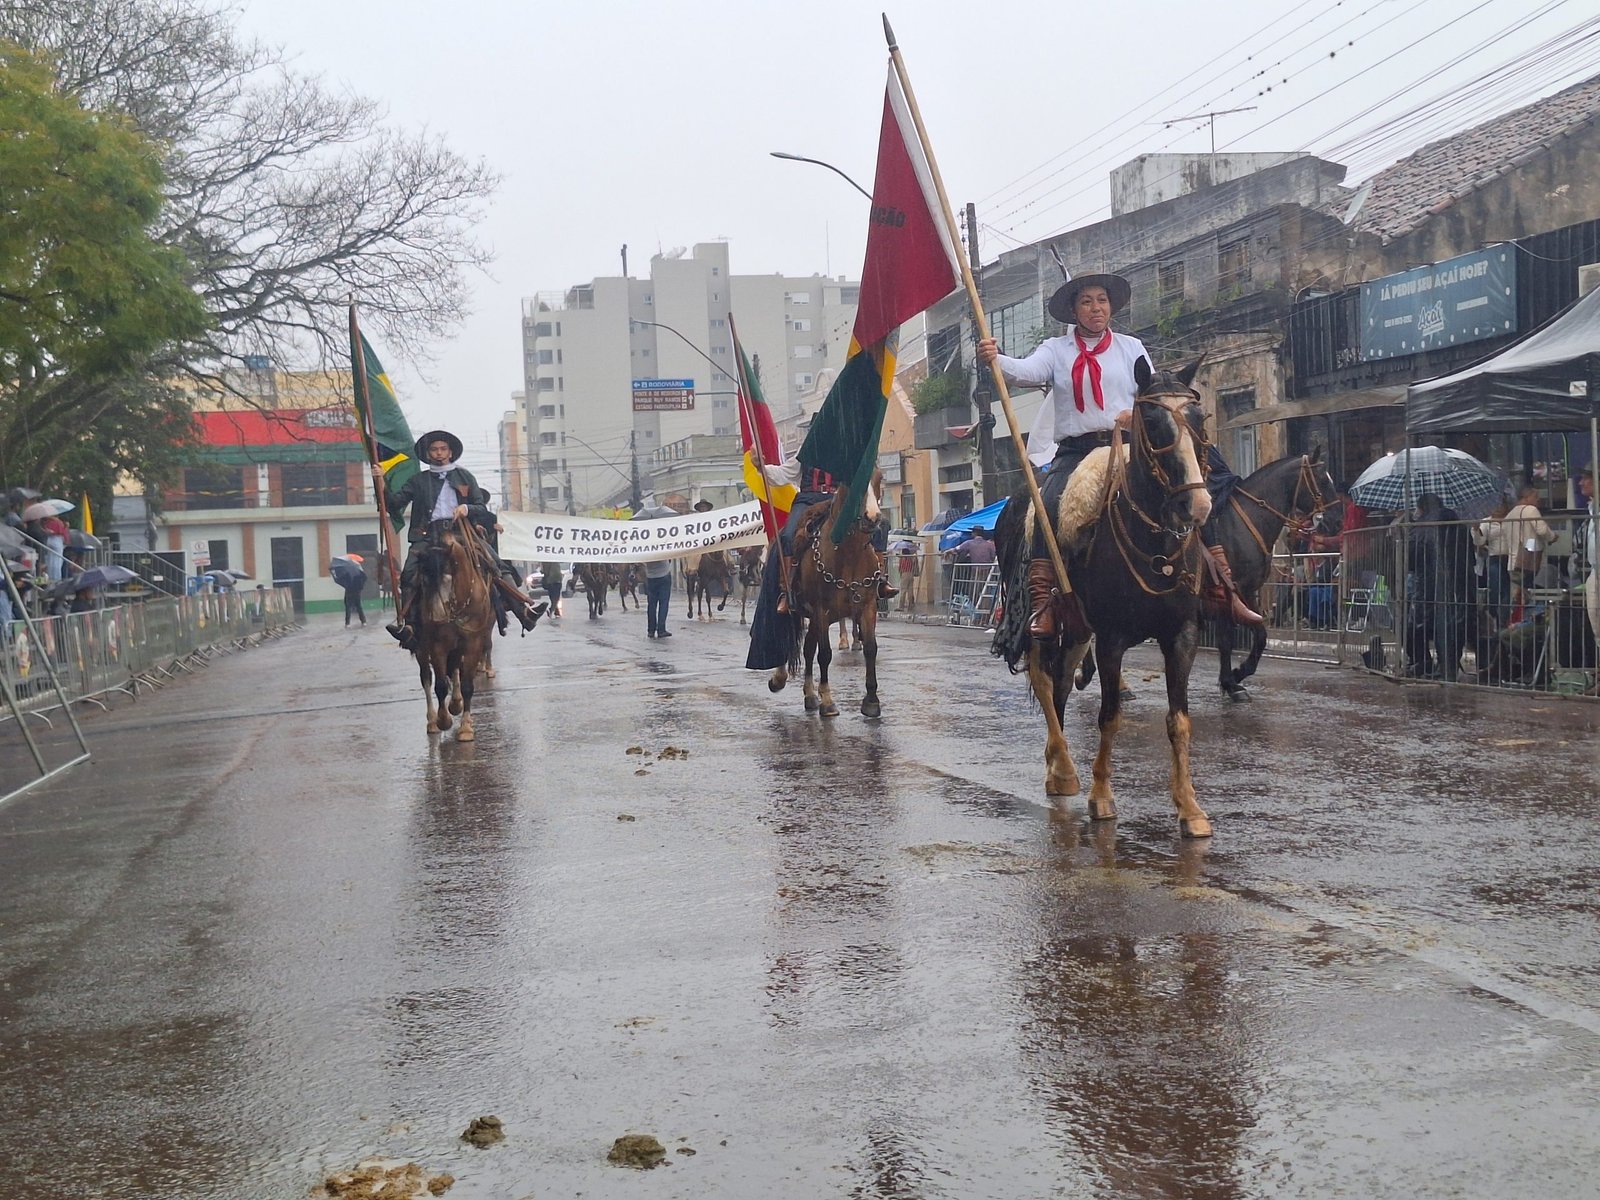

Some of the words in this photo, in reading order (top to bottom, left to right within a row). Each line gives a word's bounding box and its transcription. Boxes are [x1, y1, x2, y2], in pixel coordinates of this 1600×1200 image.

[1392, 280, 1416, 298] PEDIU
[1417, 275, 1432, 292] SEU
[1434, 265, 1458, 289] AÇAÍ
[1459, 260, 1489, 281] HOJE?
[534, 526, 563, 540] CTG
[571, 527, 650, 544] TRADIÇÃO
[656, 526, 679, 539] DO
[684, 521, 712, 536] RIO
[536, 545, 565, 555] PELA
[569, 545, 627, 557] TRADIÇÃO
[631, 539, 699, 553] MANTEMOS
[702, 536, 716, 547] OS
